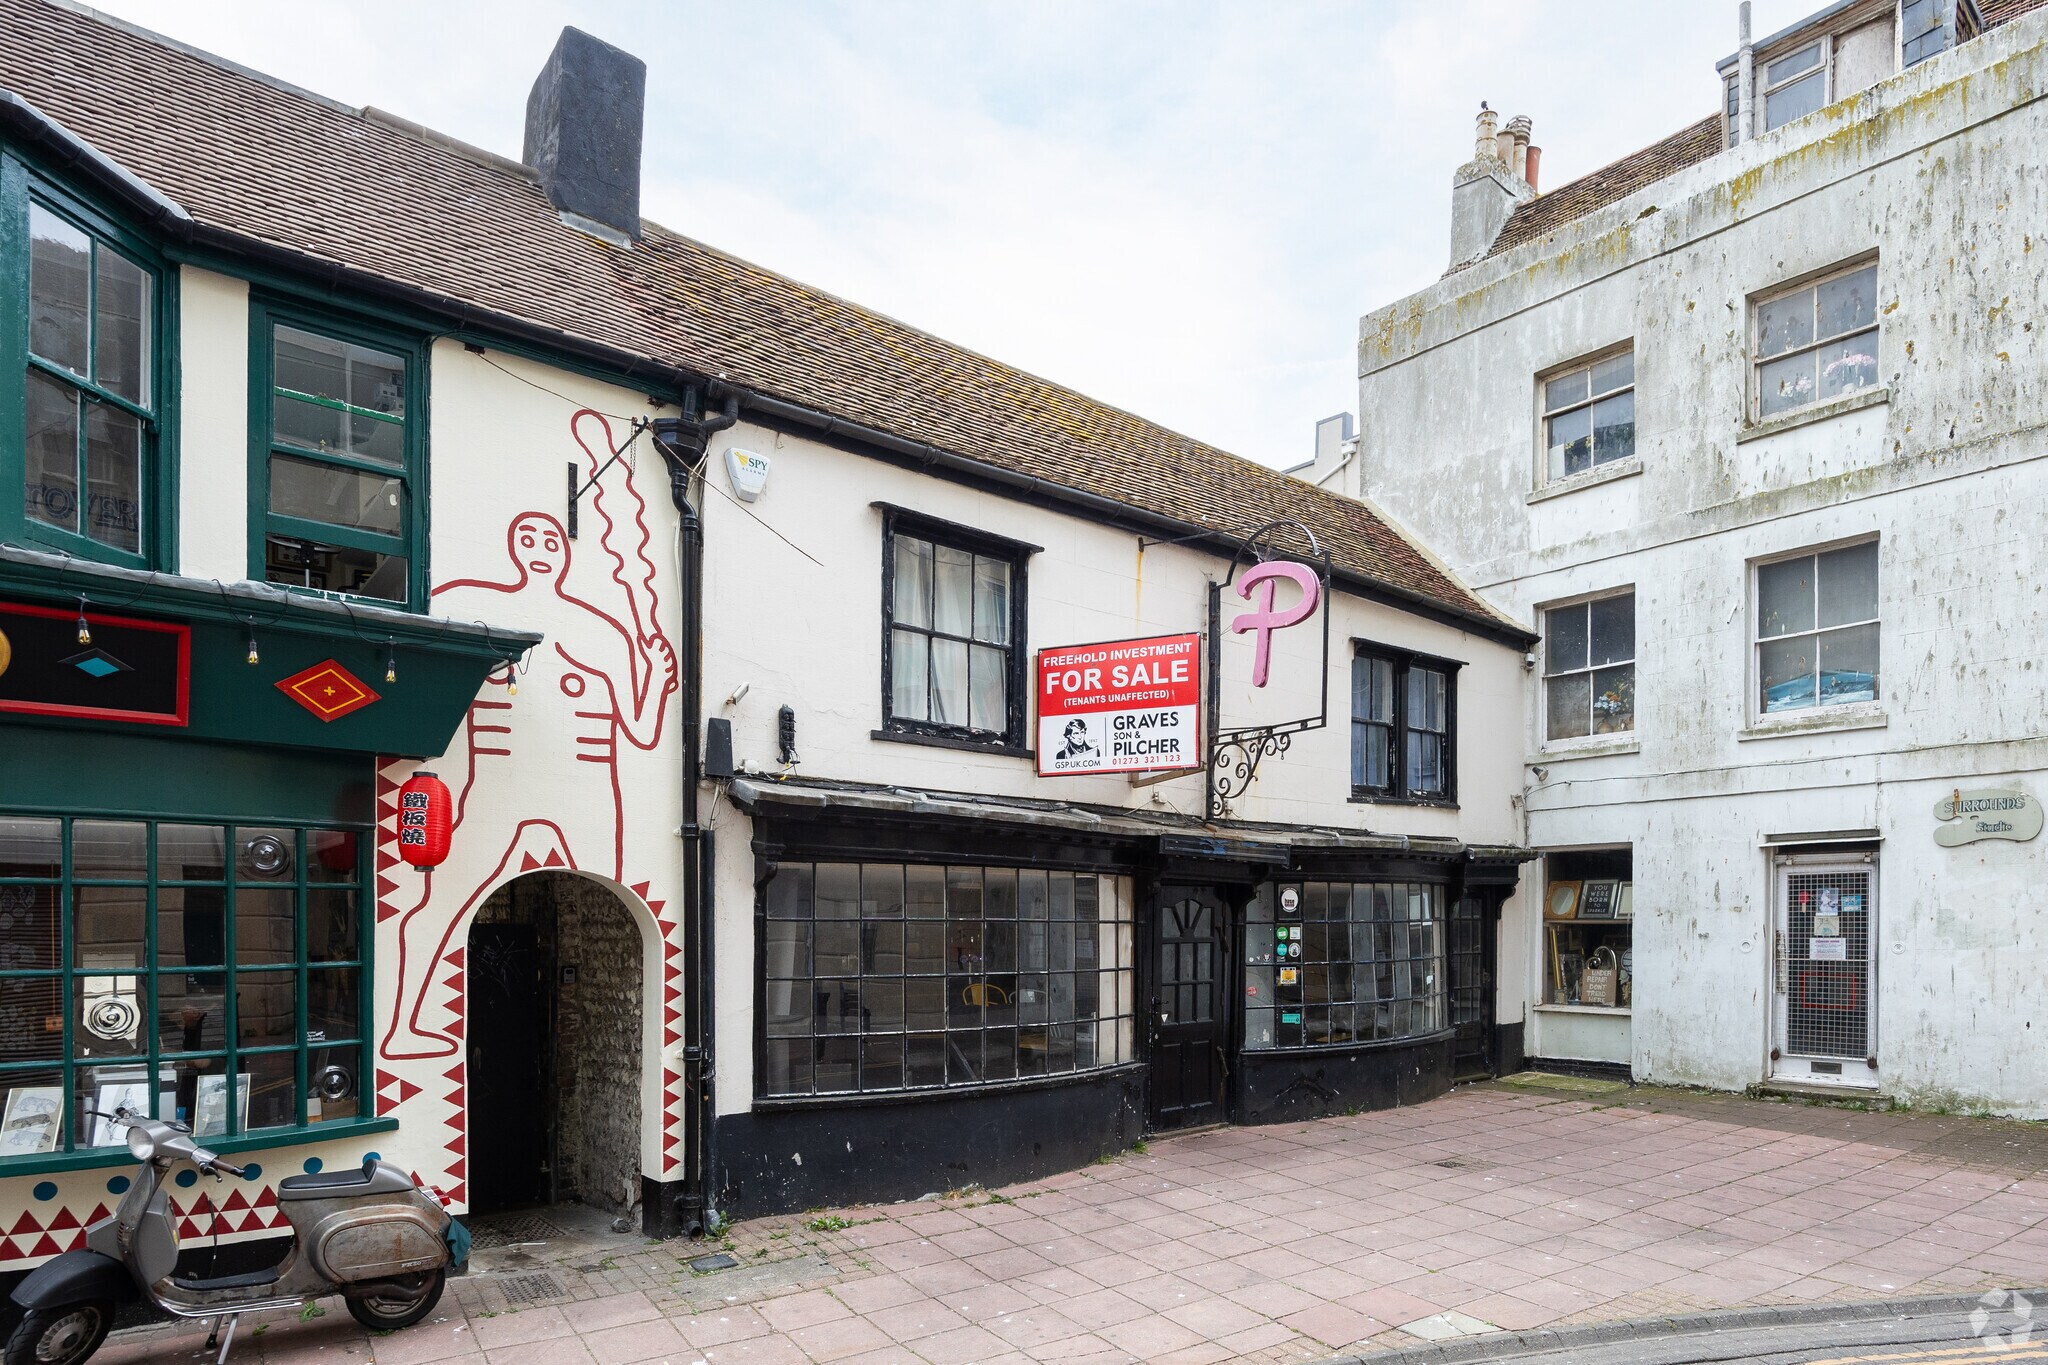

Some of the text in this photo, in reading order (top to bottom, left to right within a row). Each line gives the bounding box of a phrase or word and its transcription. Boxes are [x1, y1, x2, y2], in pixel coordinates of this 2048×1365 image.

[749, 458, 767, 471] SPY
[1231, 560, 1321, 688] P
[1043, 642, 1192, 668] FREEHOLD INVESTMENT
[1046, 659, 1189, 694] FOR SALE
[1063, 689, 1170, 708] (TENANTS UNAFFECTED)
[1113, 711, 1179, 730] GRAVES
[1113, 731, 1141, 740] SON &
[1113, 738, 1180, 756] PILCHER
[1055, 760, 1101, 769] GSP.UK.COM
[1112, 757, 1139, 765] 01273
[1944, 796, 2025, 813] SURROUNDS
[1976, 820, 2013, 832] Studio
